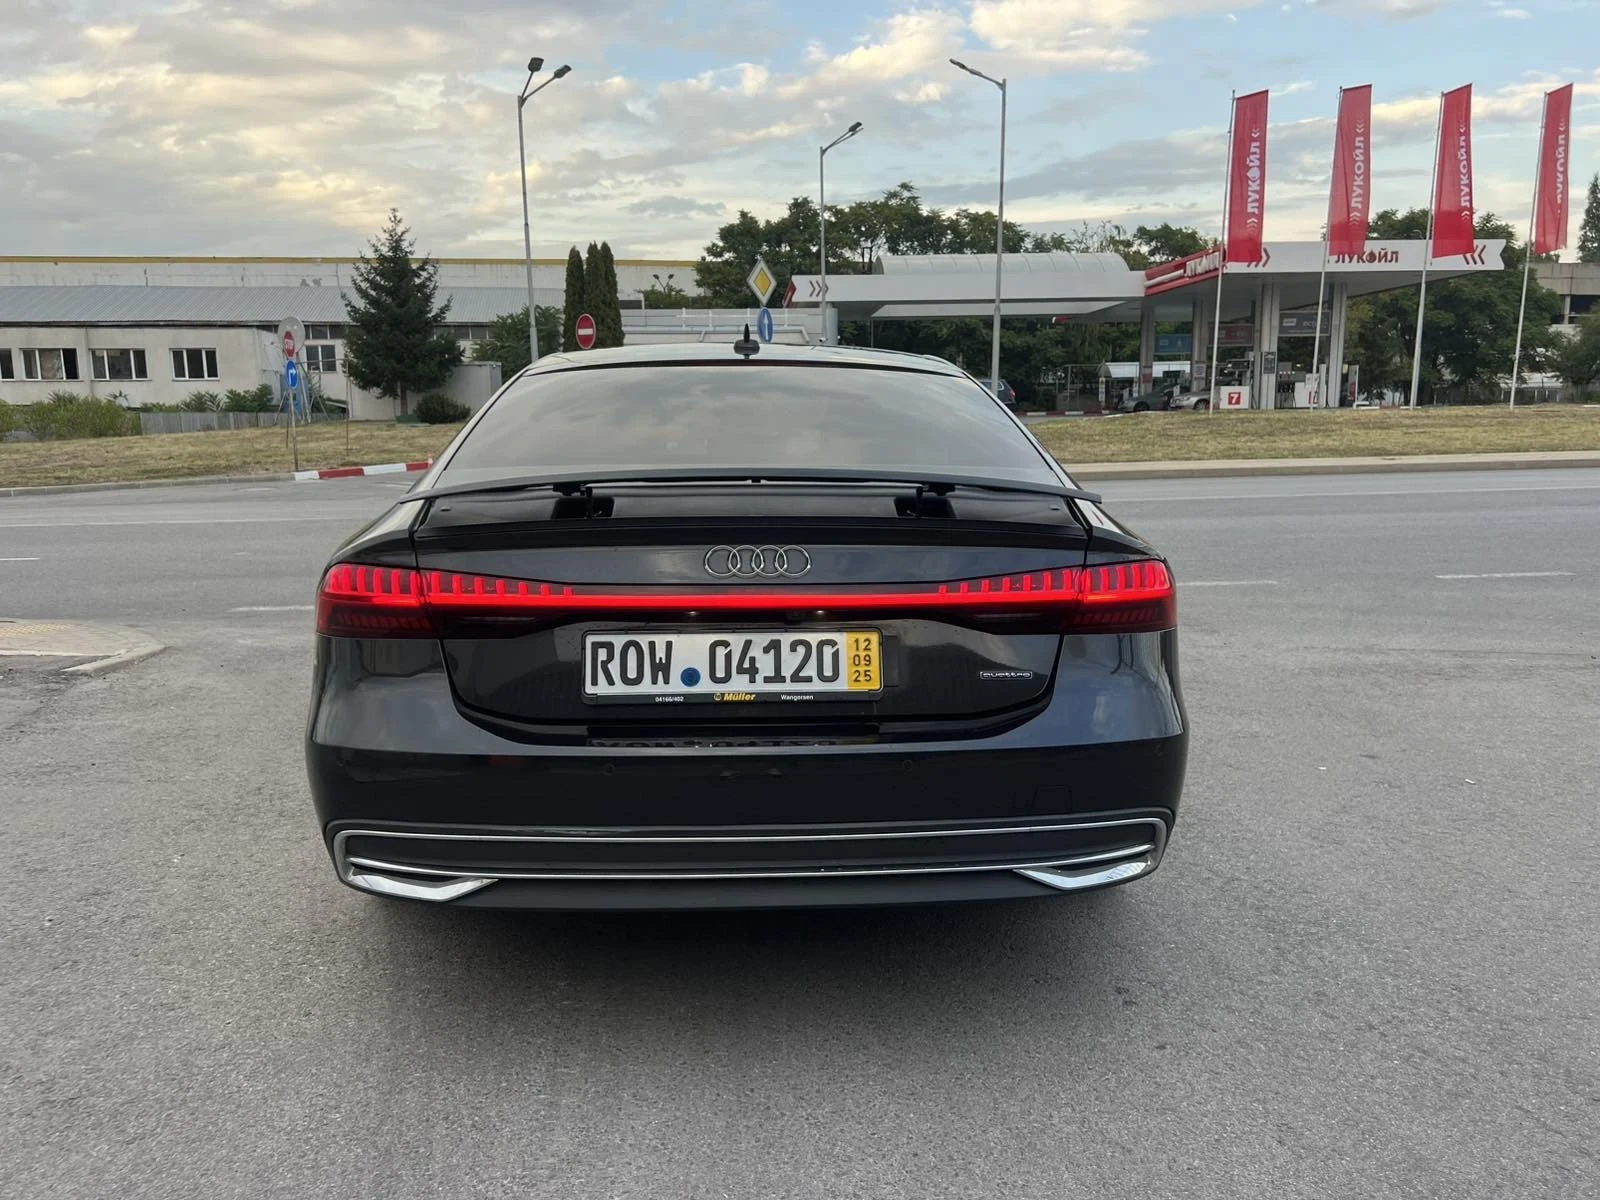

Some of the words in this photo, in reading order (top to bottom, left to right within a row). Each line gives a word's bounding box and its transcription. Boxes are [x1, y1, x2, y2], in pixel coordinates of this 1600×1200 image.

[1351, 136, 1364, 209] ЛУКОЙЛ
[1458, 135, 1470, 208] ЛУКОЙЛ
[1247, 142, 1260, 215] ЛУКОЙЛ
[1229, 394, 1239, 404] 7
[854, 638, 871, 651] 12
[591, 640, 673, 686] ROW
[709, 639, 840, 684] 04120
[853, 654, 871, 666] 09
[853, 670, 872, 683] 25
[723, 692, 756, 701] Müller
